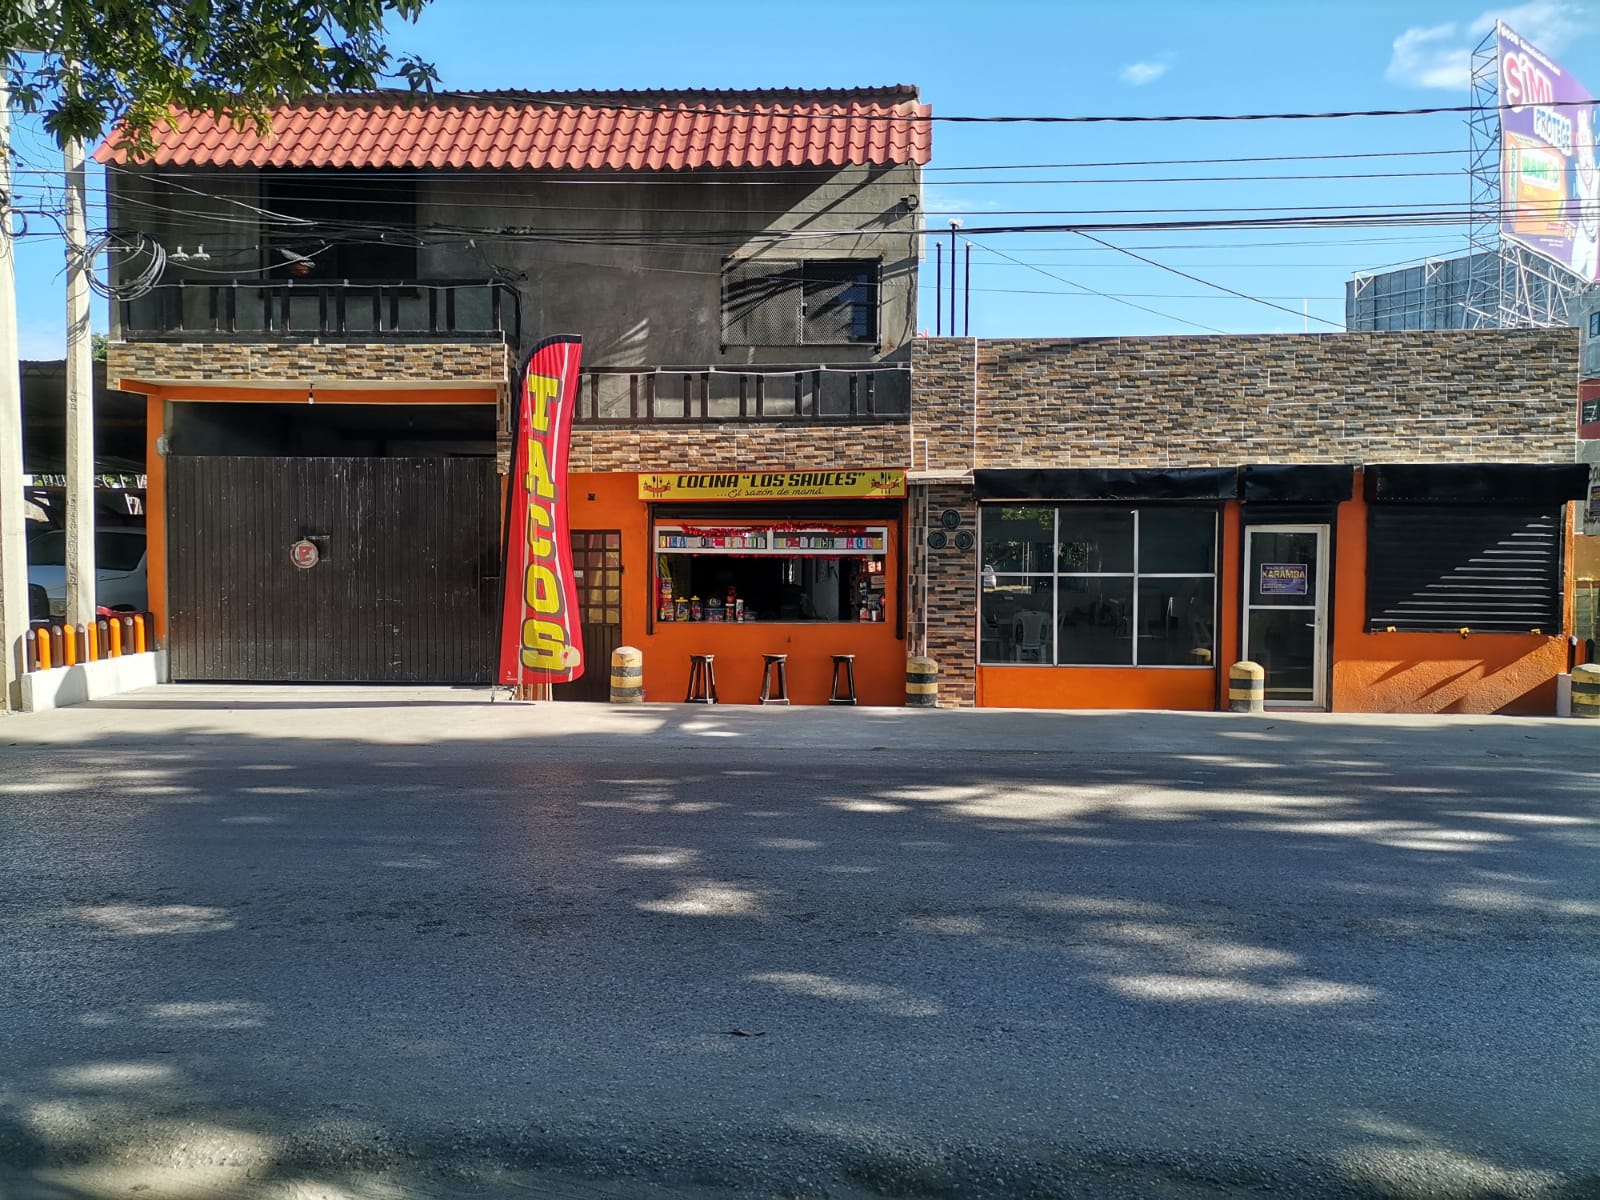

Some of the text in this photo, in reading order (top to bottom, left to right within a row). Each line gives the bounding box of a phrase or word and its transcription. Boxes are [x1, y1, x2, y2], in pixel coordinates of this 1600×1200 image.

[676, 474, 739, 489] COCINA
[776, 488, 789, 496] de
[520, 373, 570, 674] TACOS
[1262, 569, 1305, 579] KARAMBA
